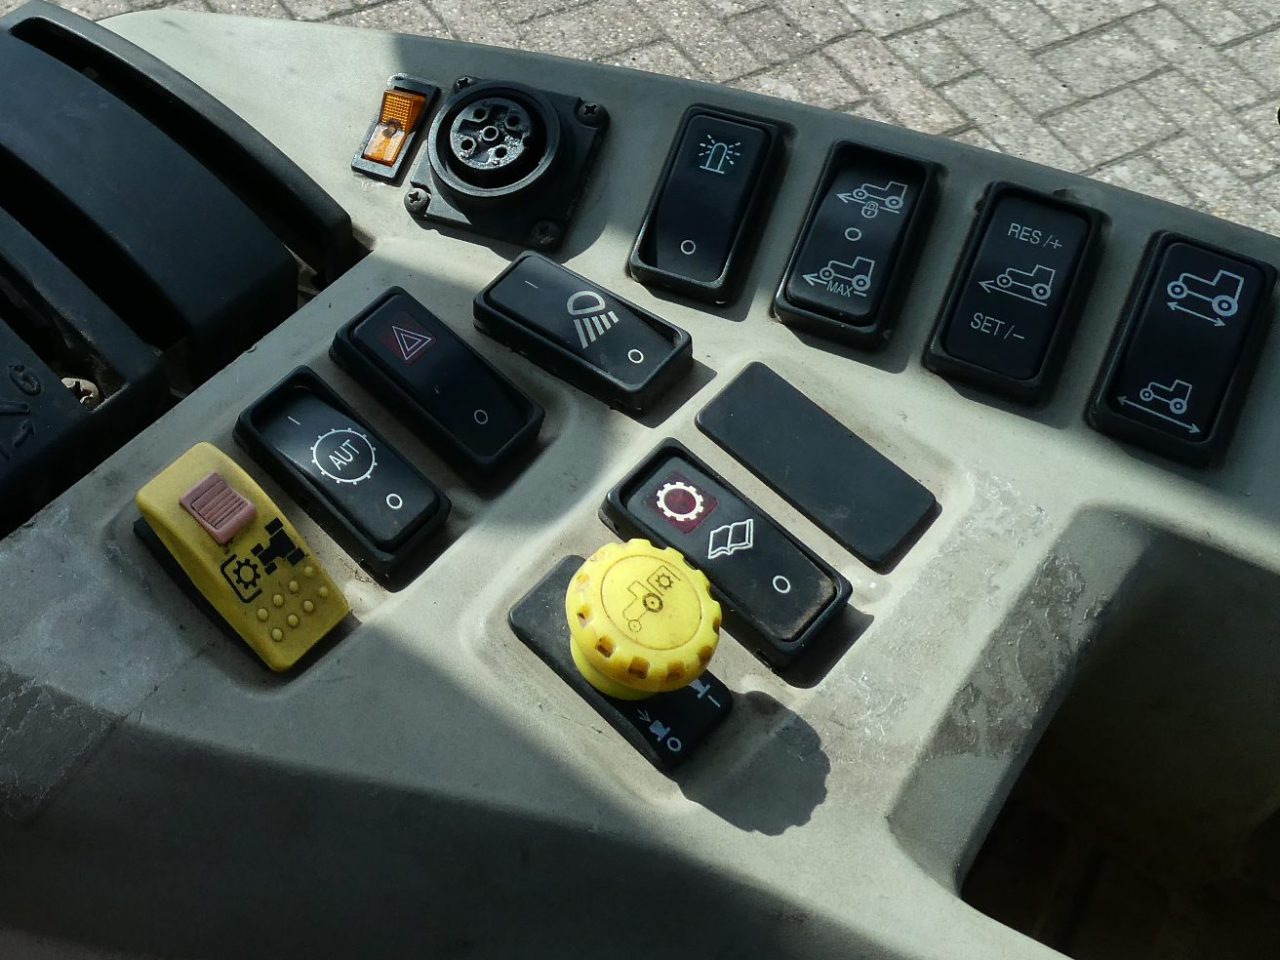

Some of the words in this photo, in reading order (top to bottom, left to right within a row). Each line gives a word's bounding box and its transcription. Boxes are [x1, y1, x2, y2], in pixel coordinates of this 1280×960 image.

[1007, 222, 1042, 245] RES
[826, 280, 853, 298] MAX
[970, 312, 1006, 336] SET
[328, 439, 360, 471] AUT
